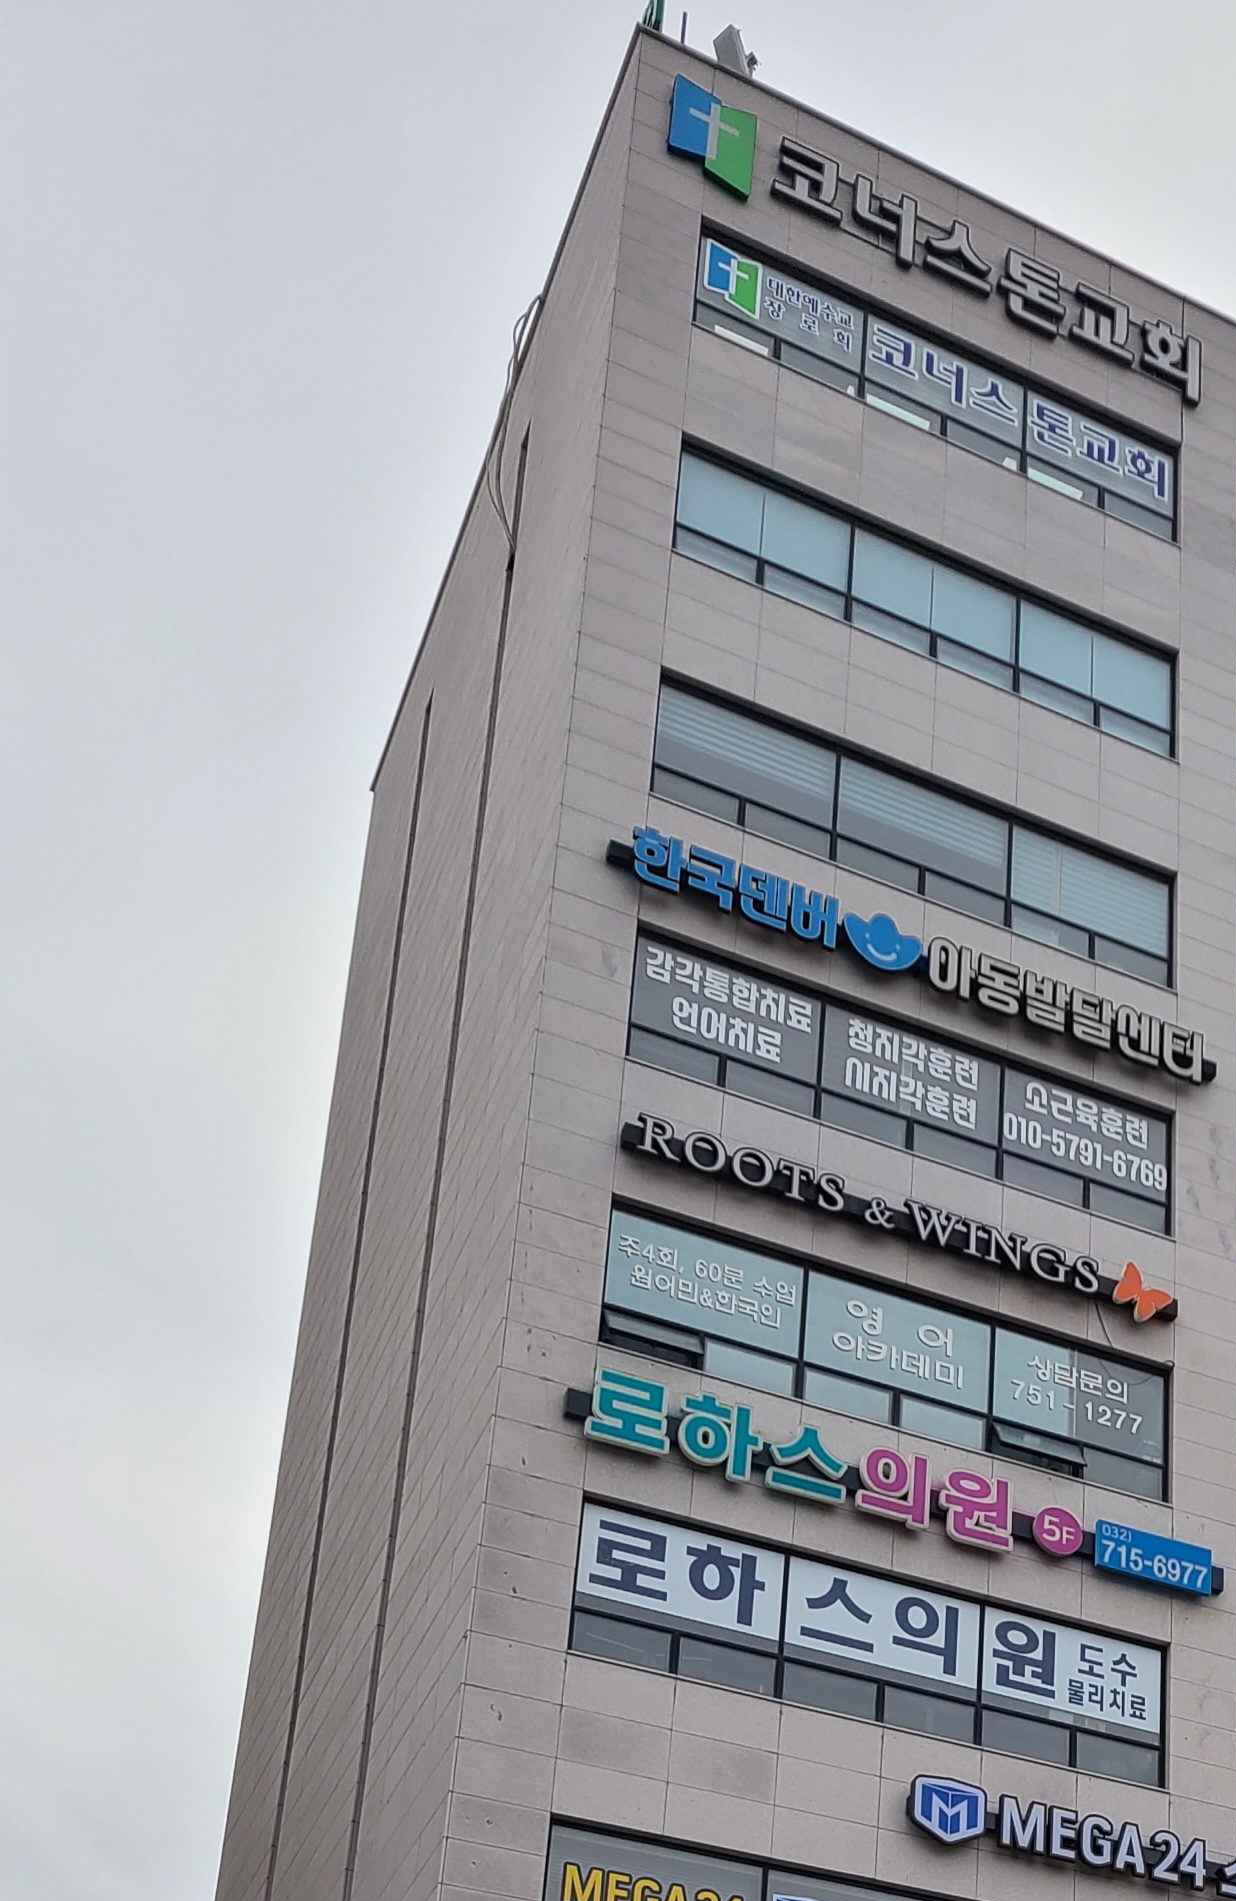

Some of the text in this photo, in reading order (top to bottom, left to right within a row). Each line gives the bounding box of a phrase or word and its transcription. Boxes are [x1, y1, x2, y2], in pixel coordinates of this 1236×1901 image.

[766, 275, 853, 326] 대한예수교
[771, 136, 1202, 406] 코너스톤교회
[632, 825, 1206, 1085] 한국덴버 아동발달센터
[644, 945, 812, 1035] 감각통합치료
[670, 995, 782, 1064] 언어치료
[846, 1018, 979, 1093] 청지각훈련
[844, 1057, 978, 1131] 시지각훈련
[1024, 1082, 1149, 1150] 소근육훈련
[1002, 1111, 1169, 1193] 010-5791-6769
[637, 1111, 1102, 1295] ROOTS & WINGS
[694, 1258, 798, 1308] 60분 수업
[831, 1331, 966, 1389] 아카데미
[1026, 1354, 1130, 1404] 상담문의
[584, 1367, 1077, 1553] 로하스의원 5F
[1101, 1523, 1133, 1542] 032)
[1101, 1540, 1209, 1588] 715-6977
[1078, 1643, 1139, 1687] 도수
[1067, 1679, 1148, 1723] 물리치료
[998, 1794, 1207, 1891] MEGA24
